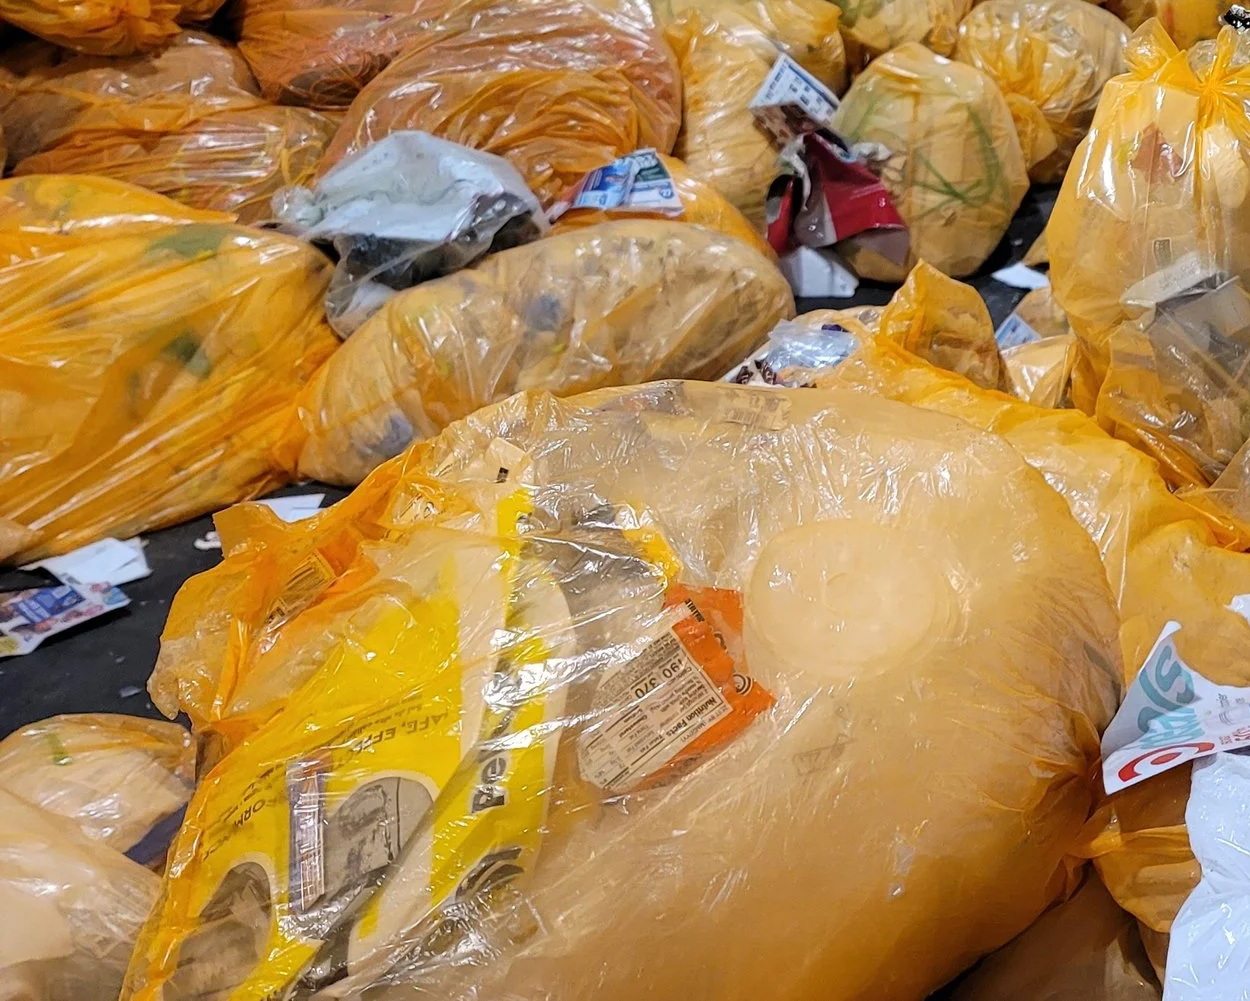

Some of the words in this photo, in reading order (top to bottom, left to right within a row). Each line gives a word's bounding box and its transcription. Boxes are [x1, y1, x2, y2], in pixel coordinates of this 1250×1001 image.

[660, 658, 685, 680] 190
[632, 676, 660, 700] 370
[400, 705, 453, 736] AFE,
[684, 696, 718, 722] Nutrition
[664, 718, 688, 738] Facts
